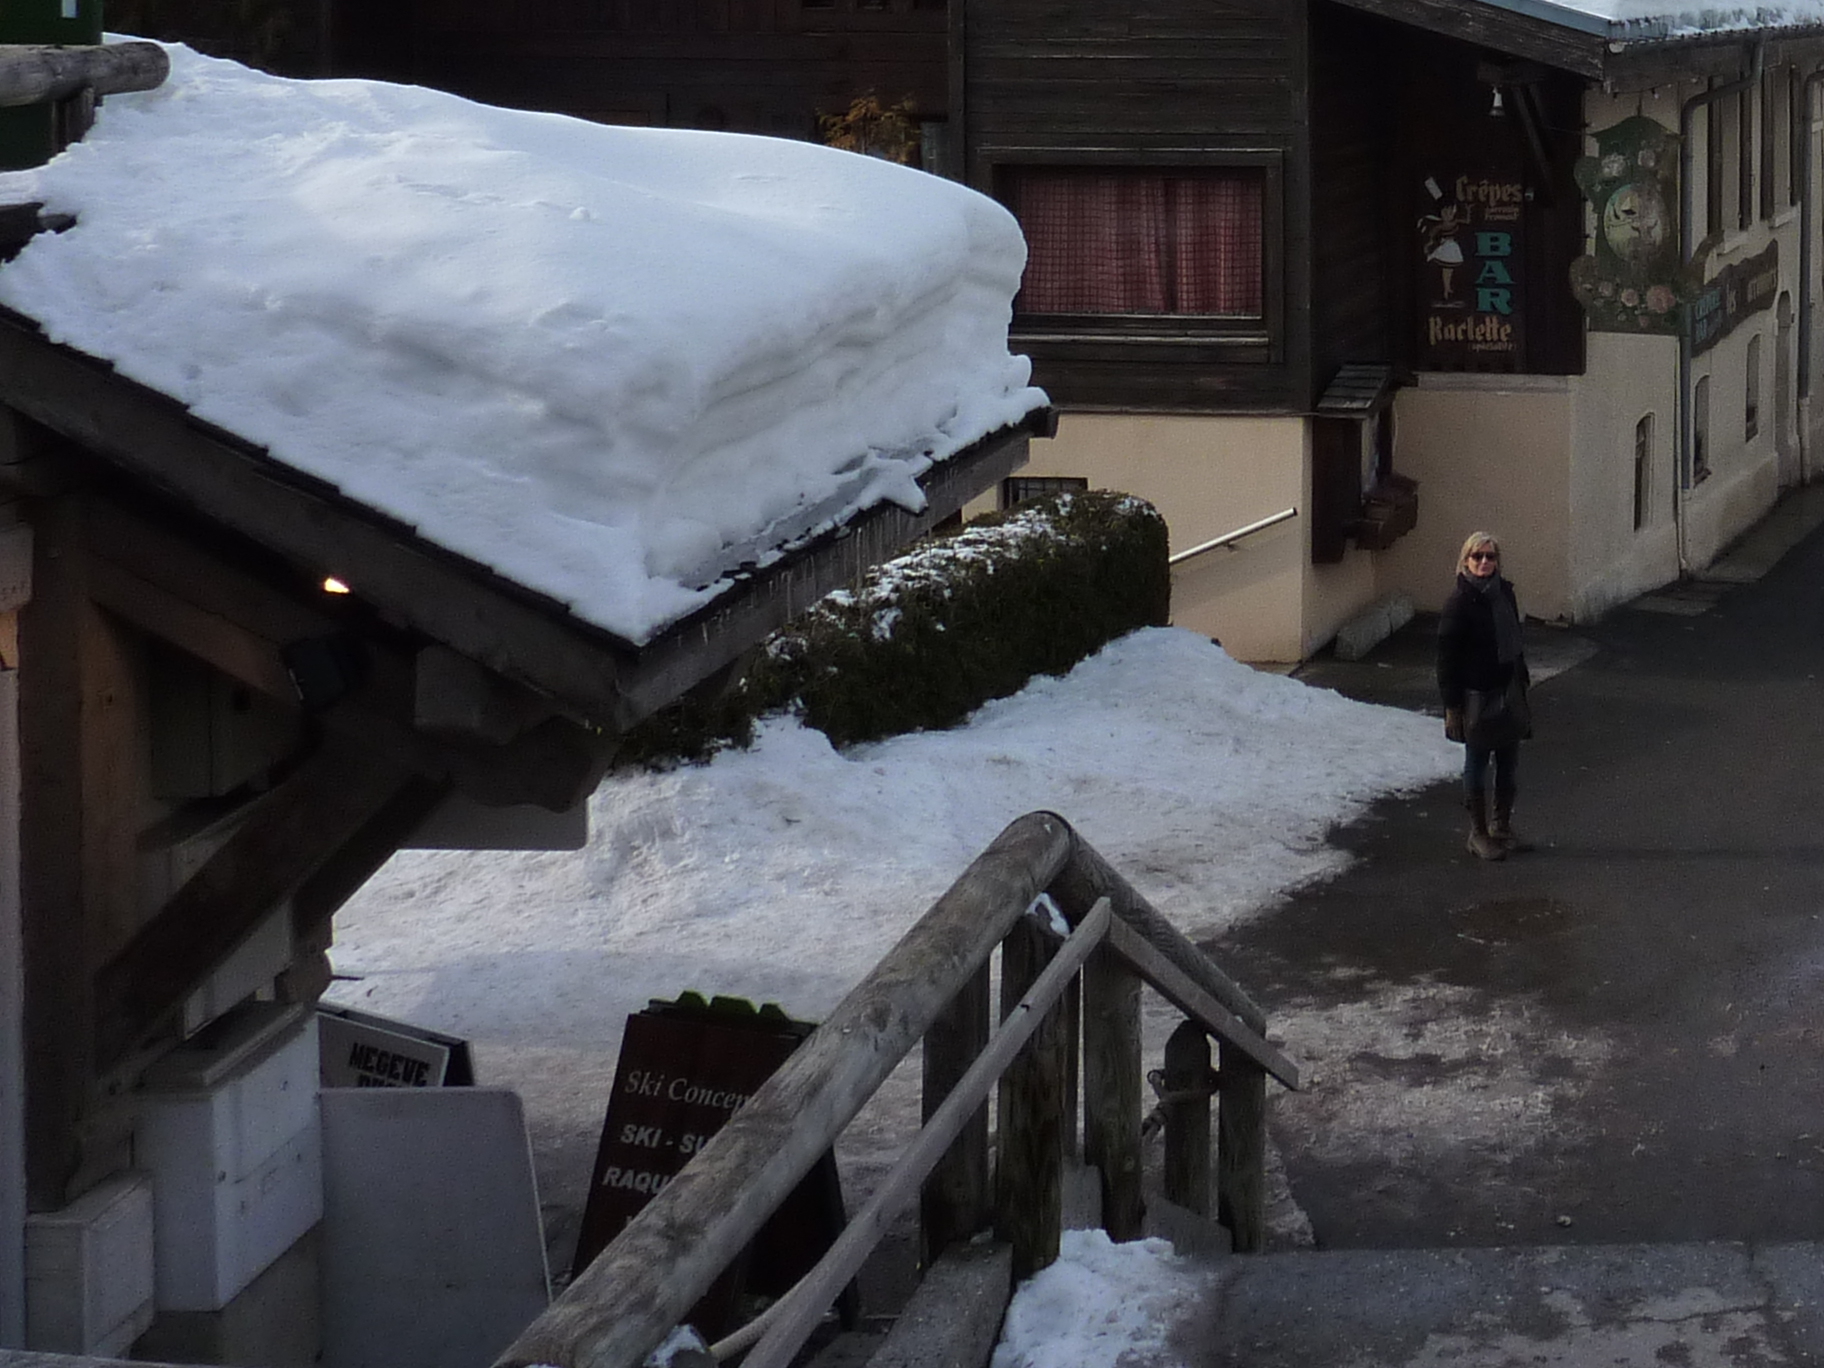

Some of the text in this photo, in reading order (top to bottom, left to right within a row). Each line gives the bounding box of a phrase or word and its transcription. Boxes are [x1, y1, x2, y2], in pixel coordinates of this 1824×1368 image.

[1455, 175, 1523, 206] Crêpes
[1474, 231, 1517, 316] BAR
[1428, 314, 1512, 346] Raclette
[624, 1070, 666, 1096] Ski
[620, 1124, 663, 1148] SKI
